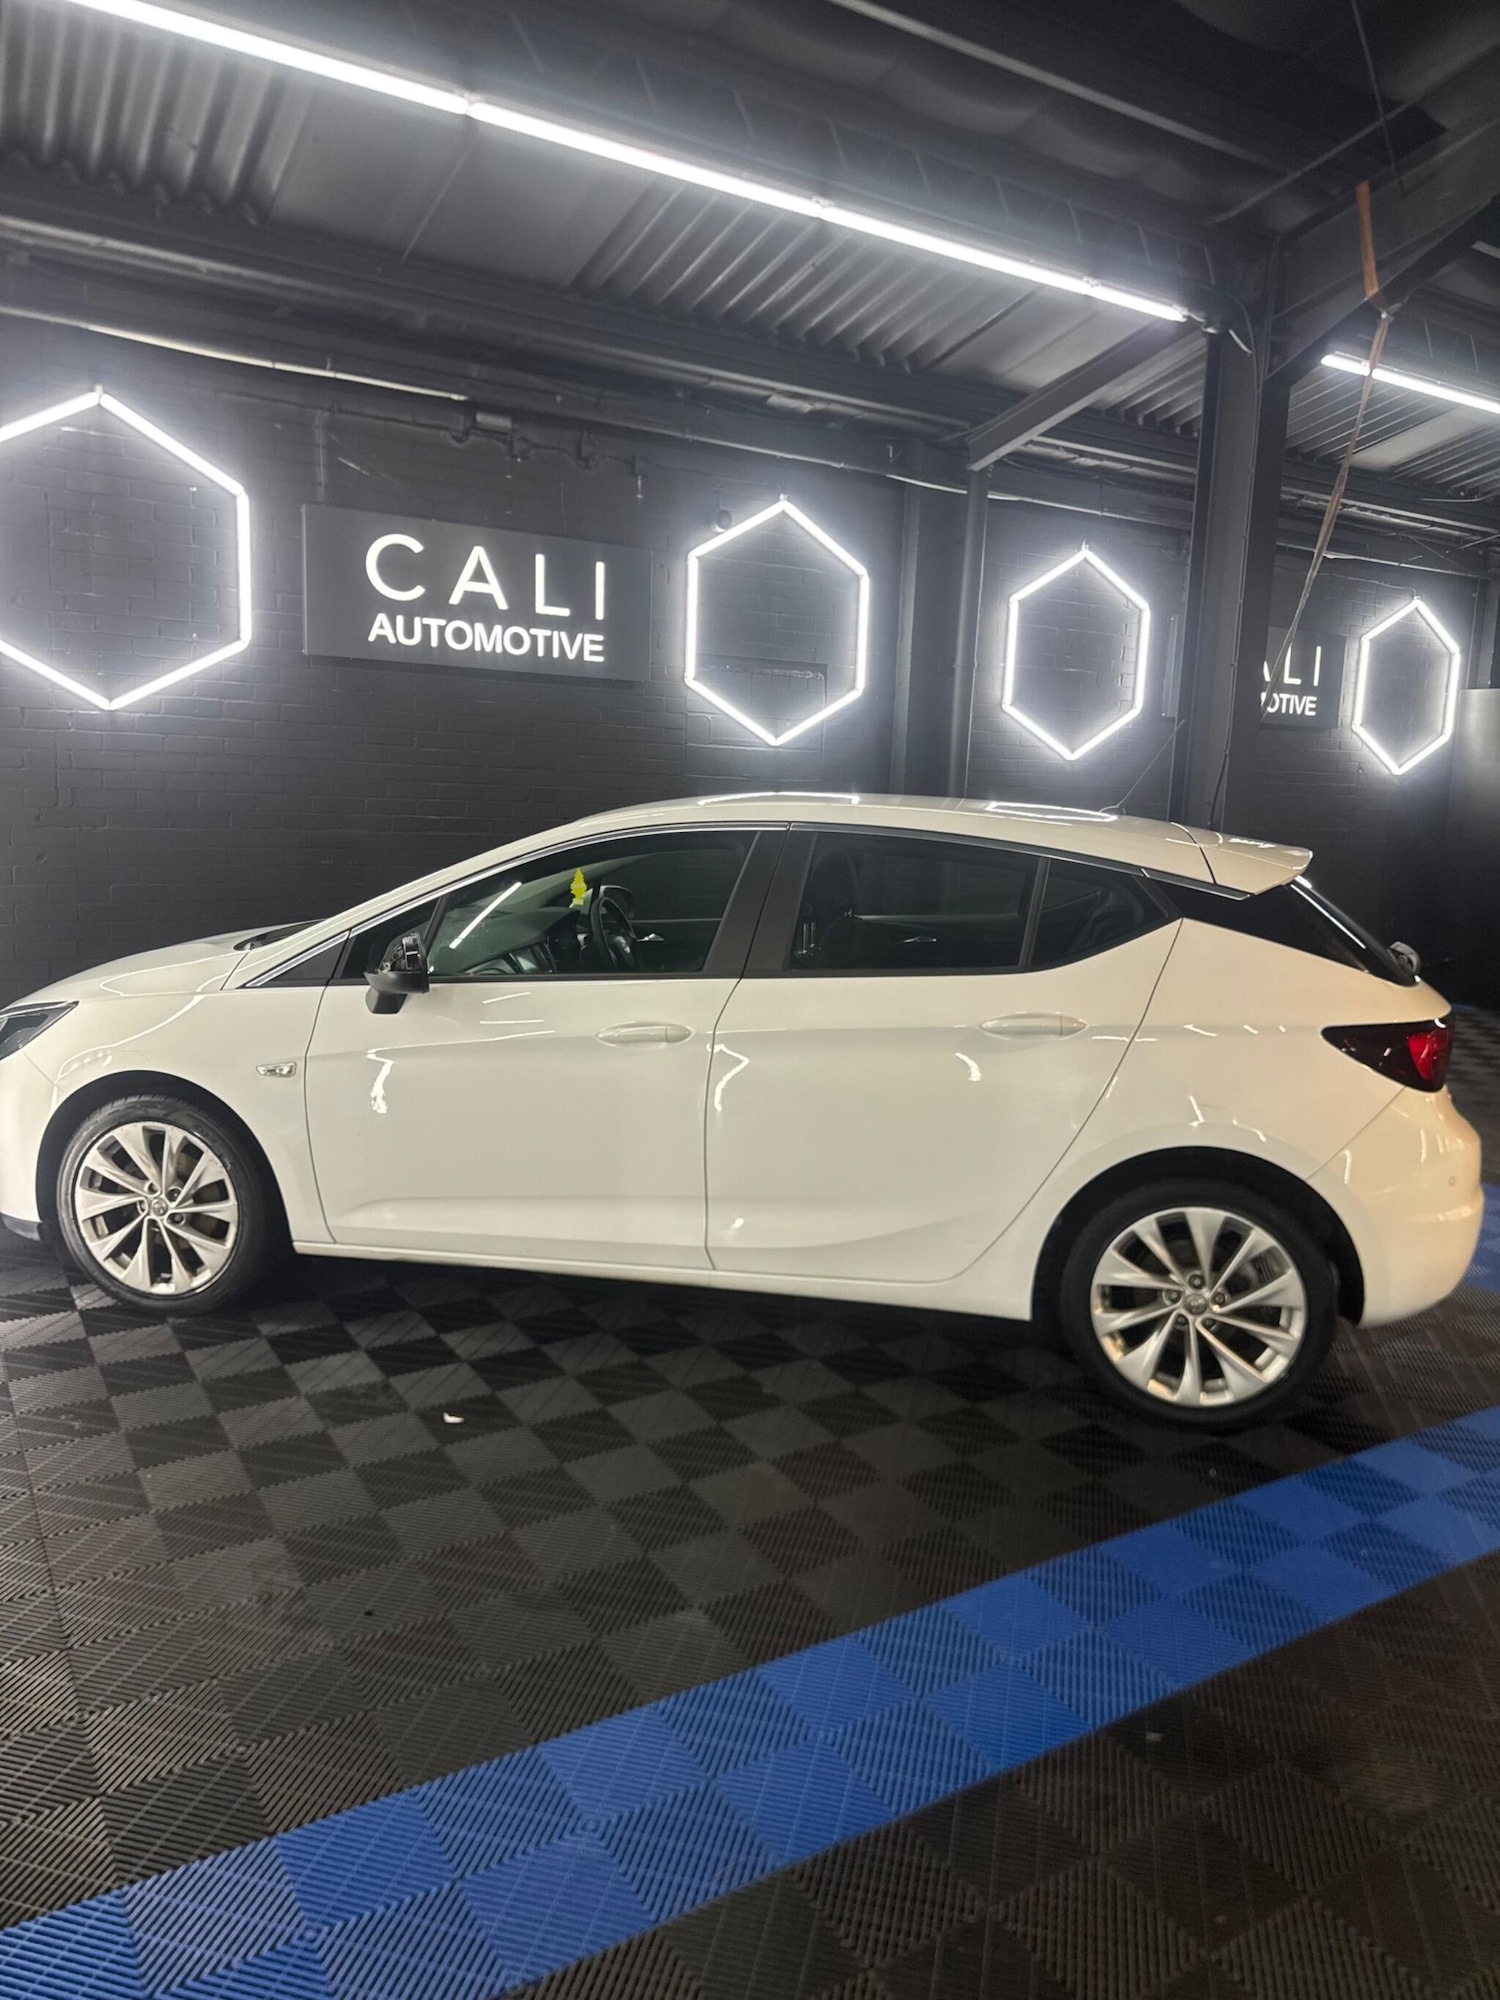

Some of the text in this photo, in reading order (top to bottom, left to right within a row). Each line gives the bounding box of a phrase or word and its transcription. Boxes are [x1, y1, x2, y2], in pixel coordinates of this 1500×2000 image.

[365, 533, 605, 620] CALI
[368, 613, 605, 662] AUTOMOTIVE
[1263, 644, 1321, 686] LI
[1261, 692, 1317, 716] OTIVE
